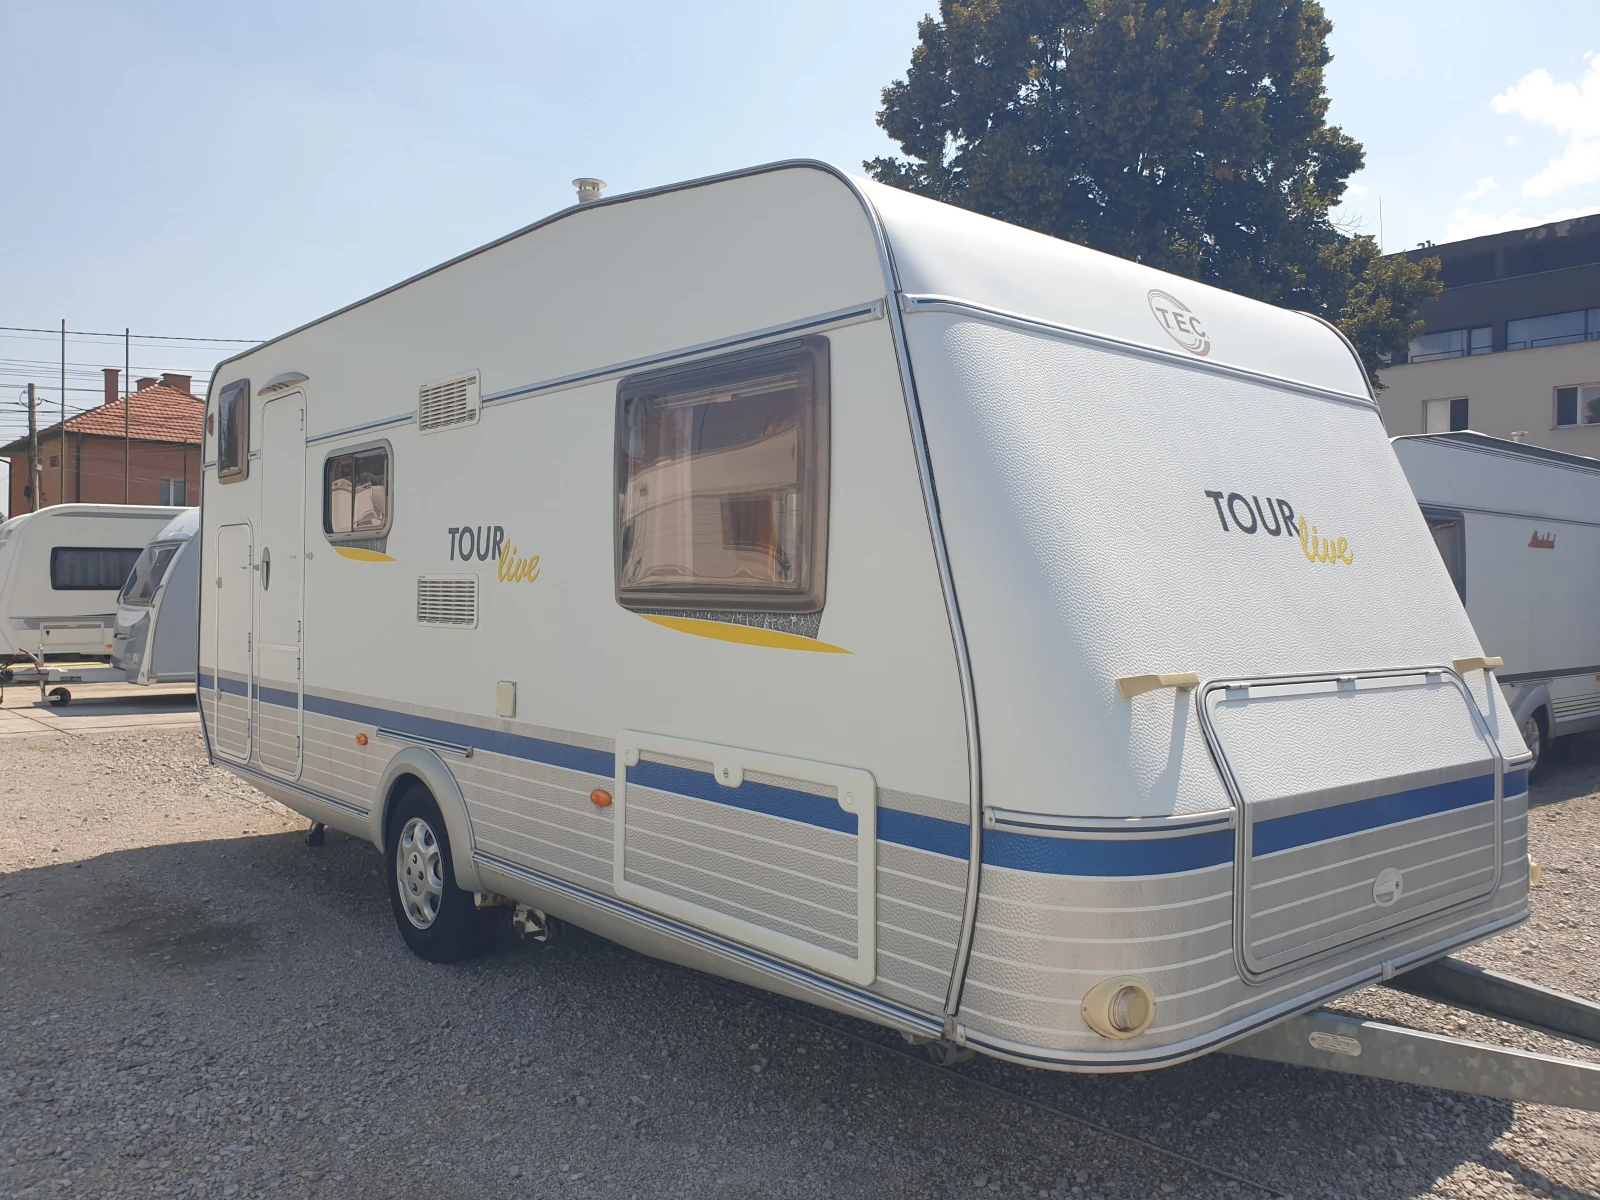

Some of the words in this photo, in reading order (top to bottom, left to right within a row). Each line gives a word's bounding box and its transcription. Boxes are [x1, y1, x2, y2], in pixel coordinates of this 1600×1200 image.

[448, 525, 504, 561] TOUR
[498, 538, 540, 583] live
[1204, 489, 1301, 537] TOUR
[1299, 516, 1353, 565] live
